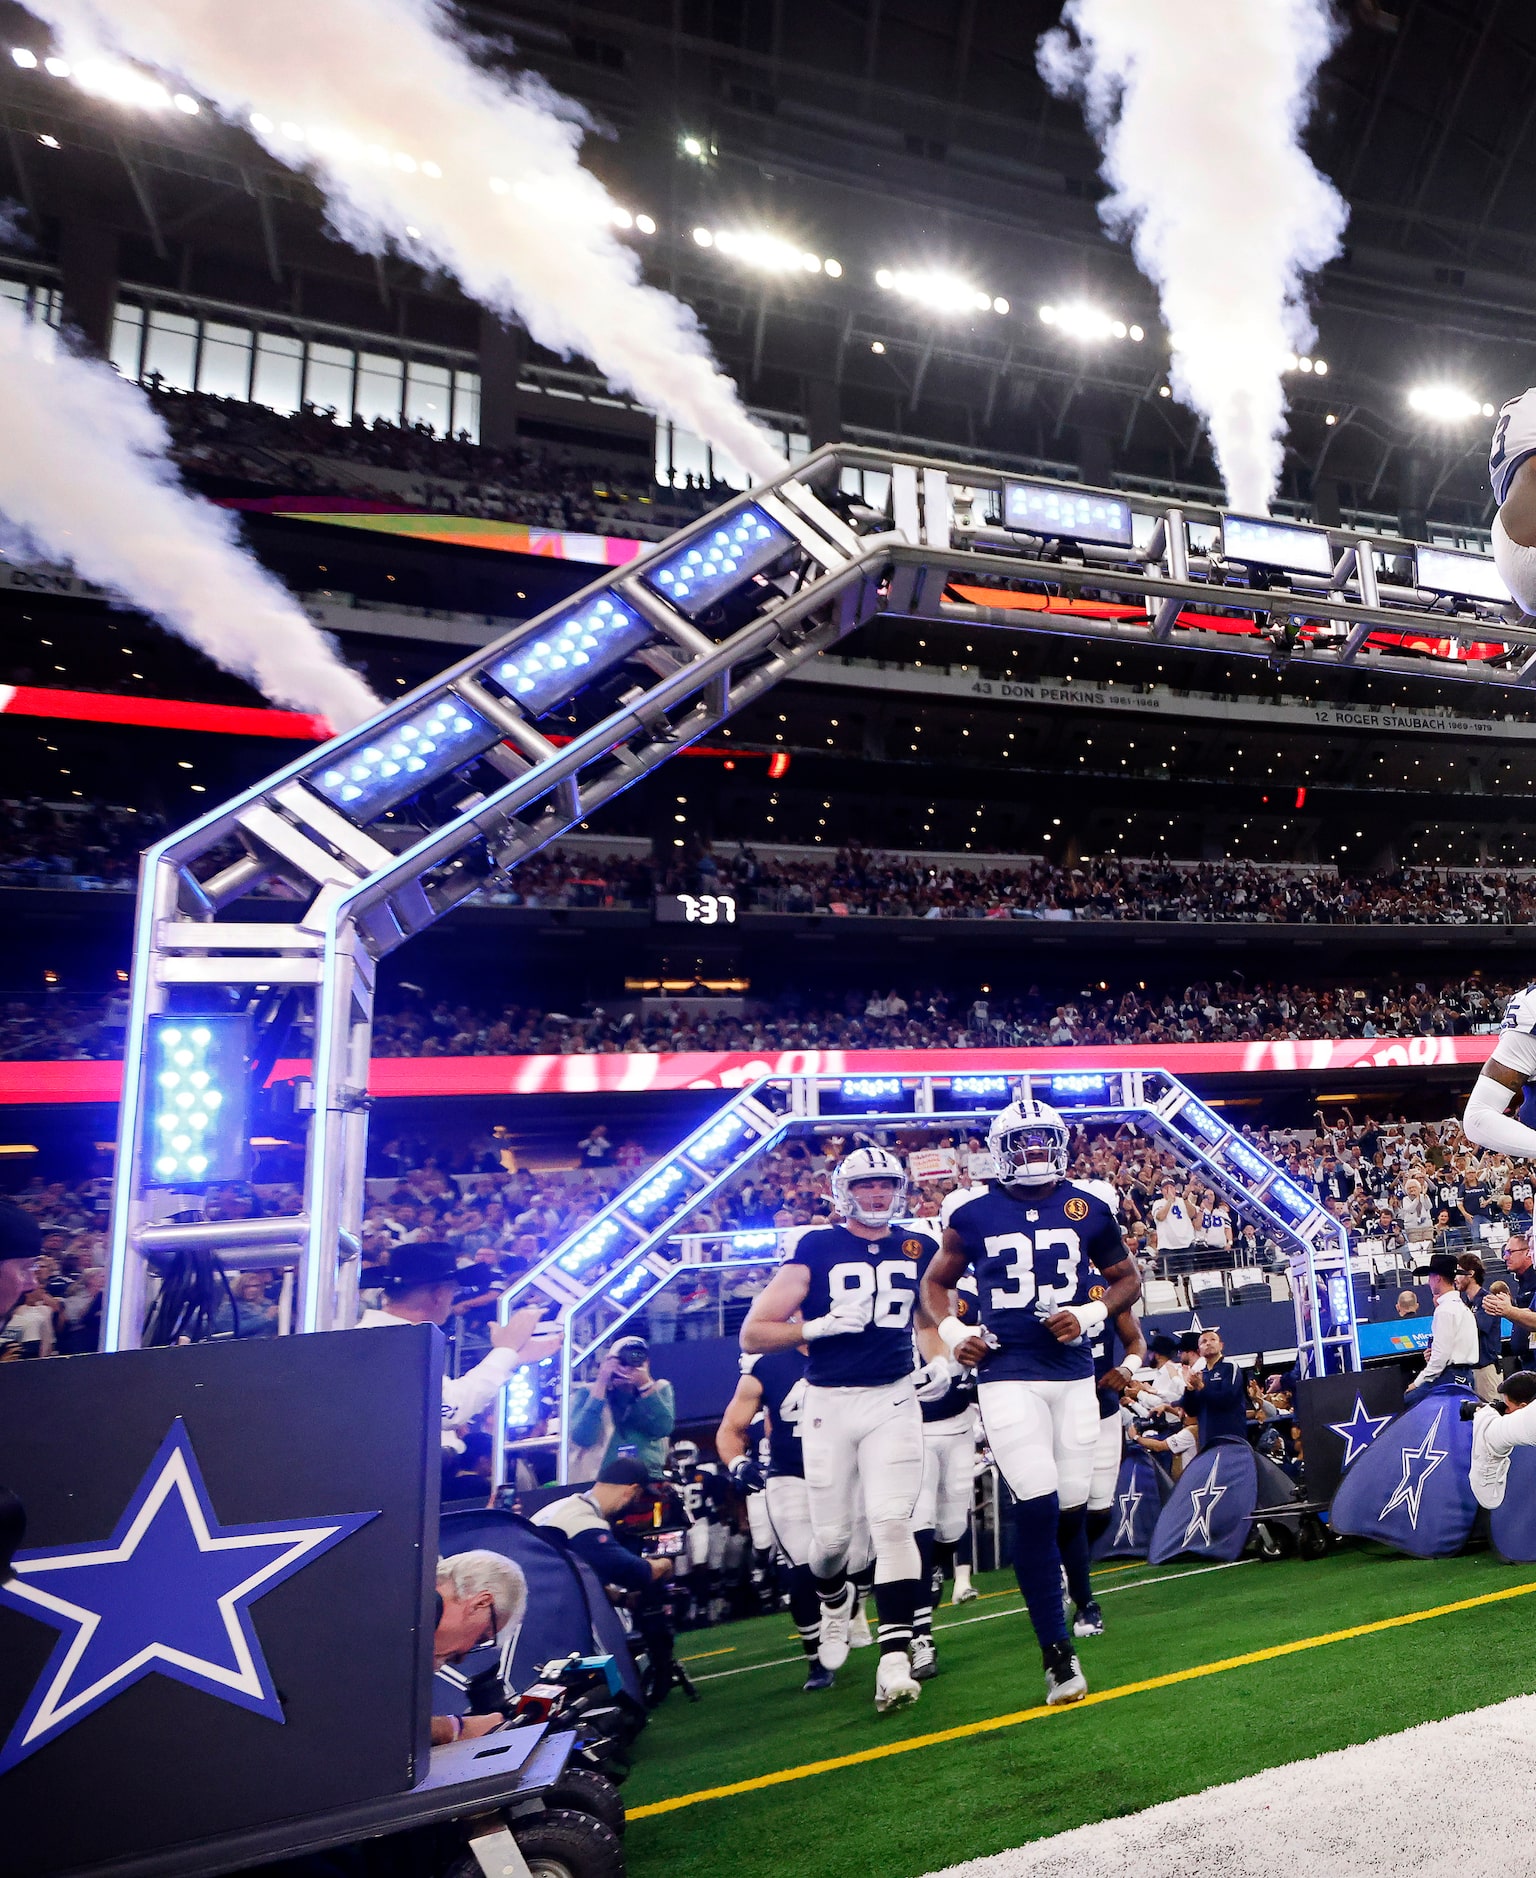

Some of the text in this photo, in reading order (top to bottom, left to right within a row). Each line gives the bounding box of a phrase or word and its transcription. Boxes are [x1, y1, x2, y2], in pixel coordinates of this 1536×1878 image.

[971, 682, 992, 694] 43
[1001, 684, 1034, 699] DON
[1040, 687, 1104, 704] PERKINS
[1315, 711, 1329, 722] 12
[1335, 712, 1379, 726] ROGER
[1383, 716, 1445, 730] STAUBACH
[676, 893, 736, 925] 7:37
[984, 1228, 1081, 1310] 33
[828, 1260, 918, 1329] 86
